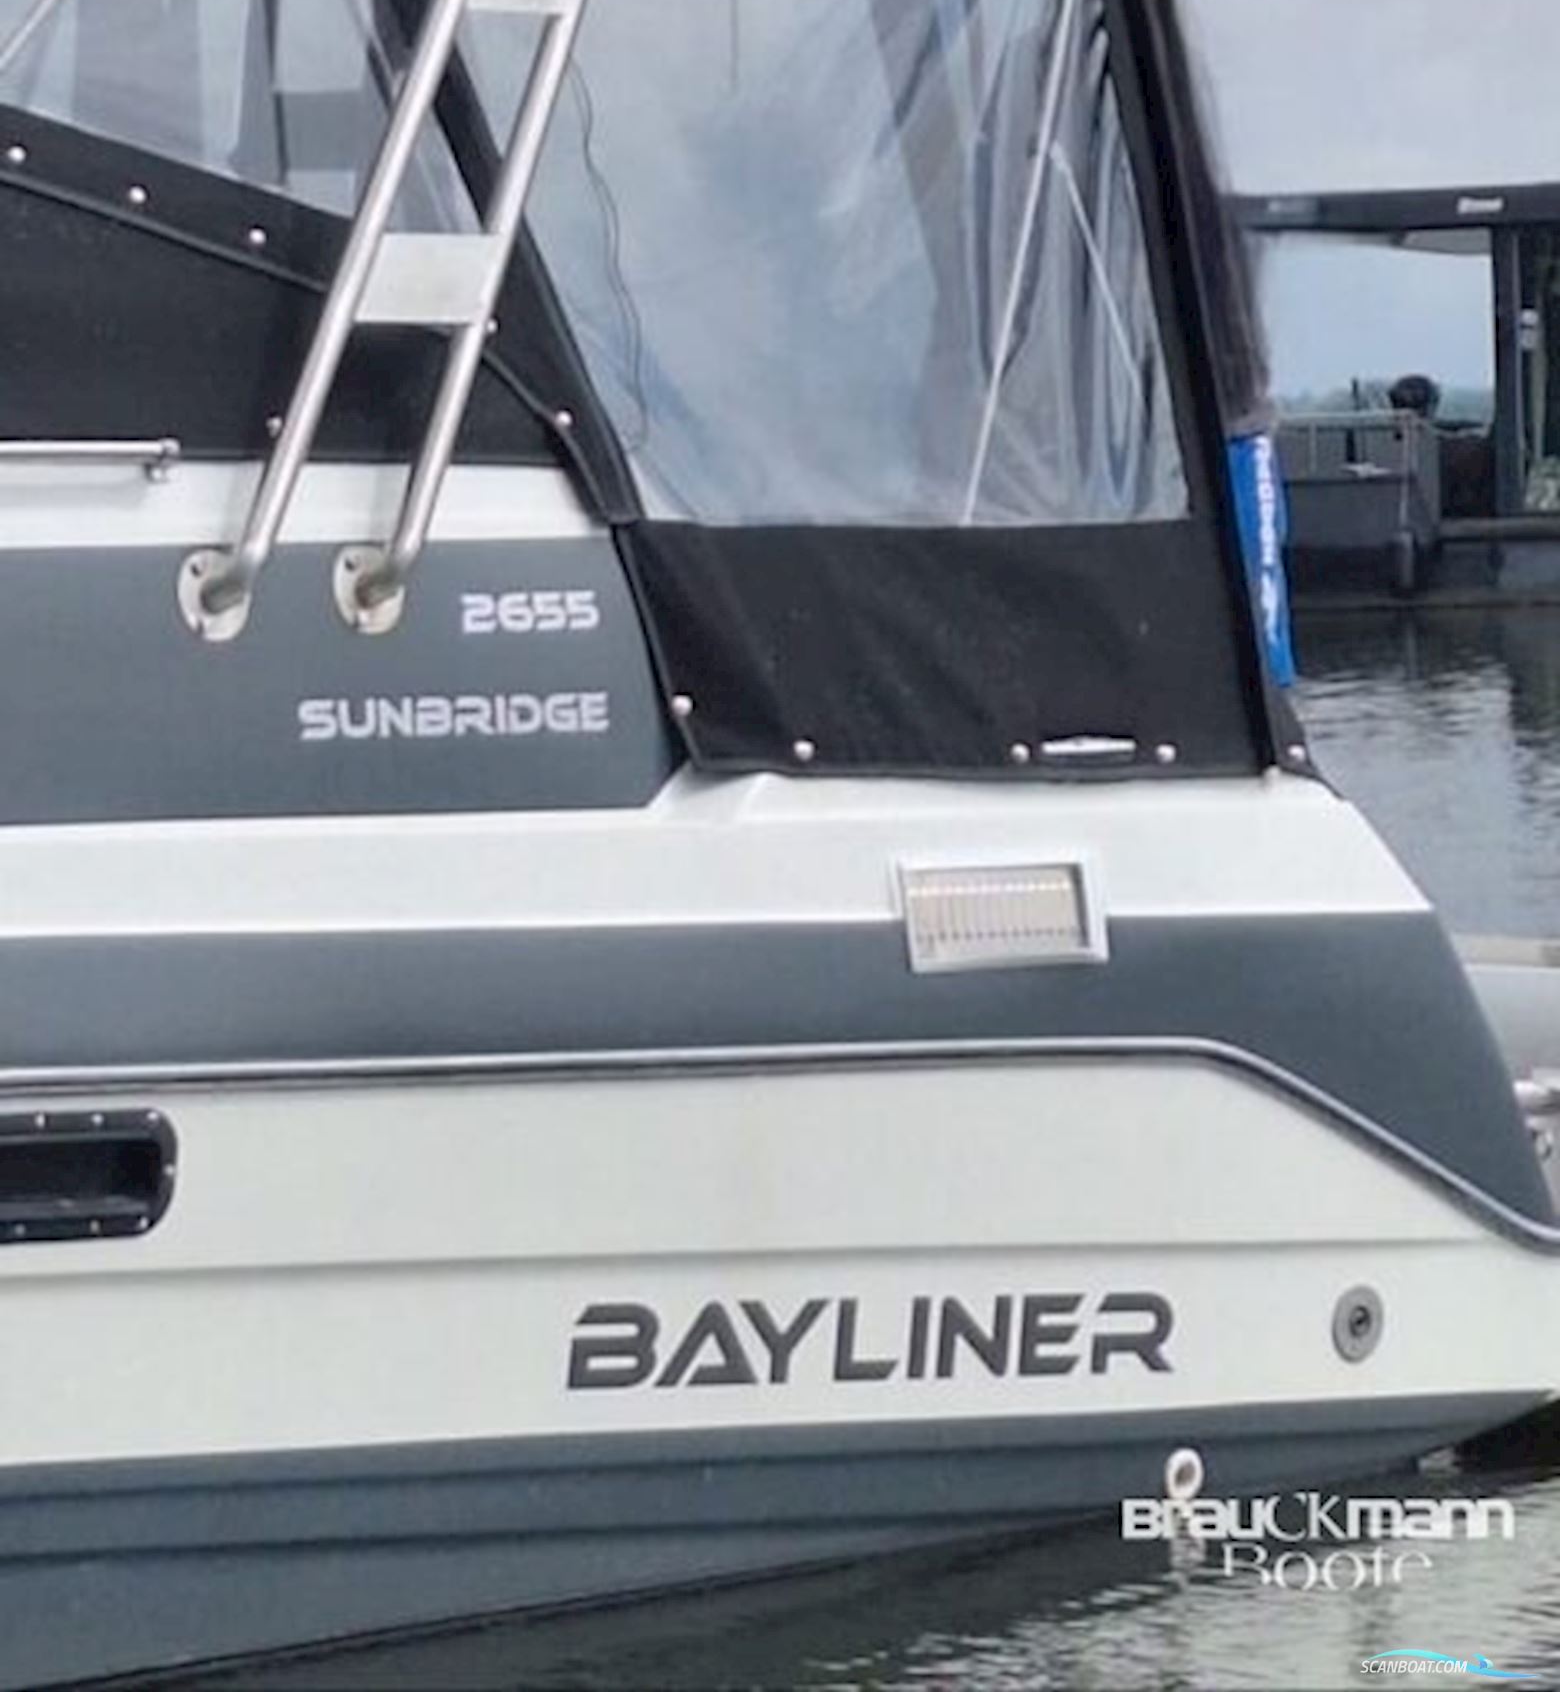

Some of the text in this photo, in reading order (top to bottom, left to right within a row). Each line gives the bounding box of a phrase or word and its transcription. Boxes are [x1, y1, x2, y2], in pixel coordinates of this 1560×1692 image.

[460, 590, 600, 634] 2655
[298, 692, 610, 740] SUNBRIDGE
[567, 1292, 1175, 1390] BAYLINER
